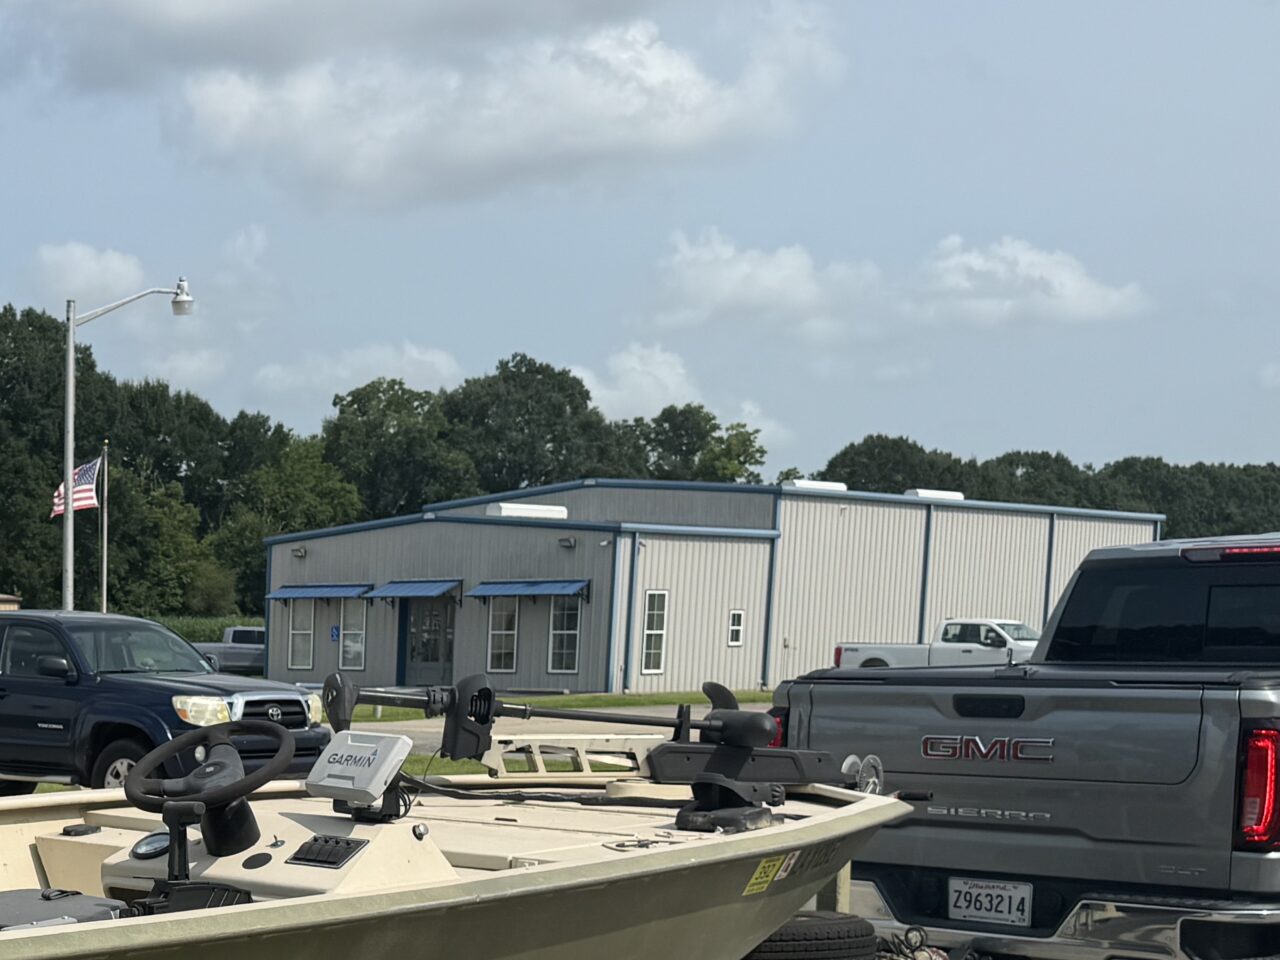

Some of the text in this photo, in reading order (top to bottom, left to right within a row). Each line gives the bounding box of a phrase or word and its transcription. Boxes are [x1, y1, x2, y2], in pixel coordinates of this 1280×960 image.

[921, 734, 1054, 761] GMC
[327, 753, 376, 768] GARMIN
[927, 806, 1051, 820] SIERRA
[953, 889, 1025, 916] Z963214
